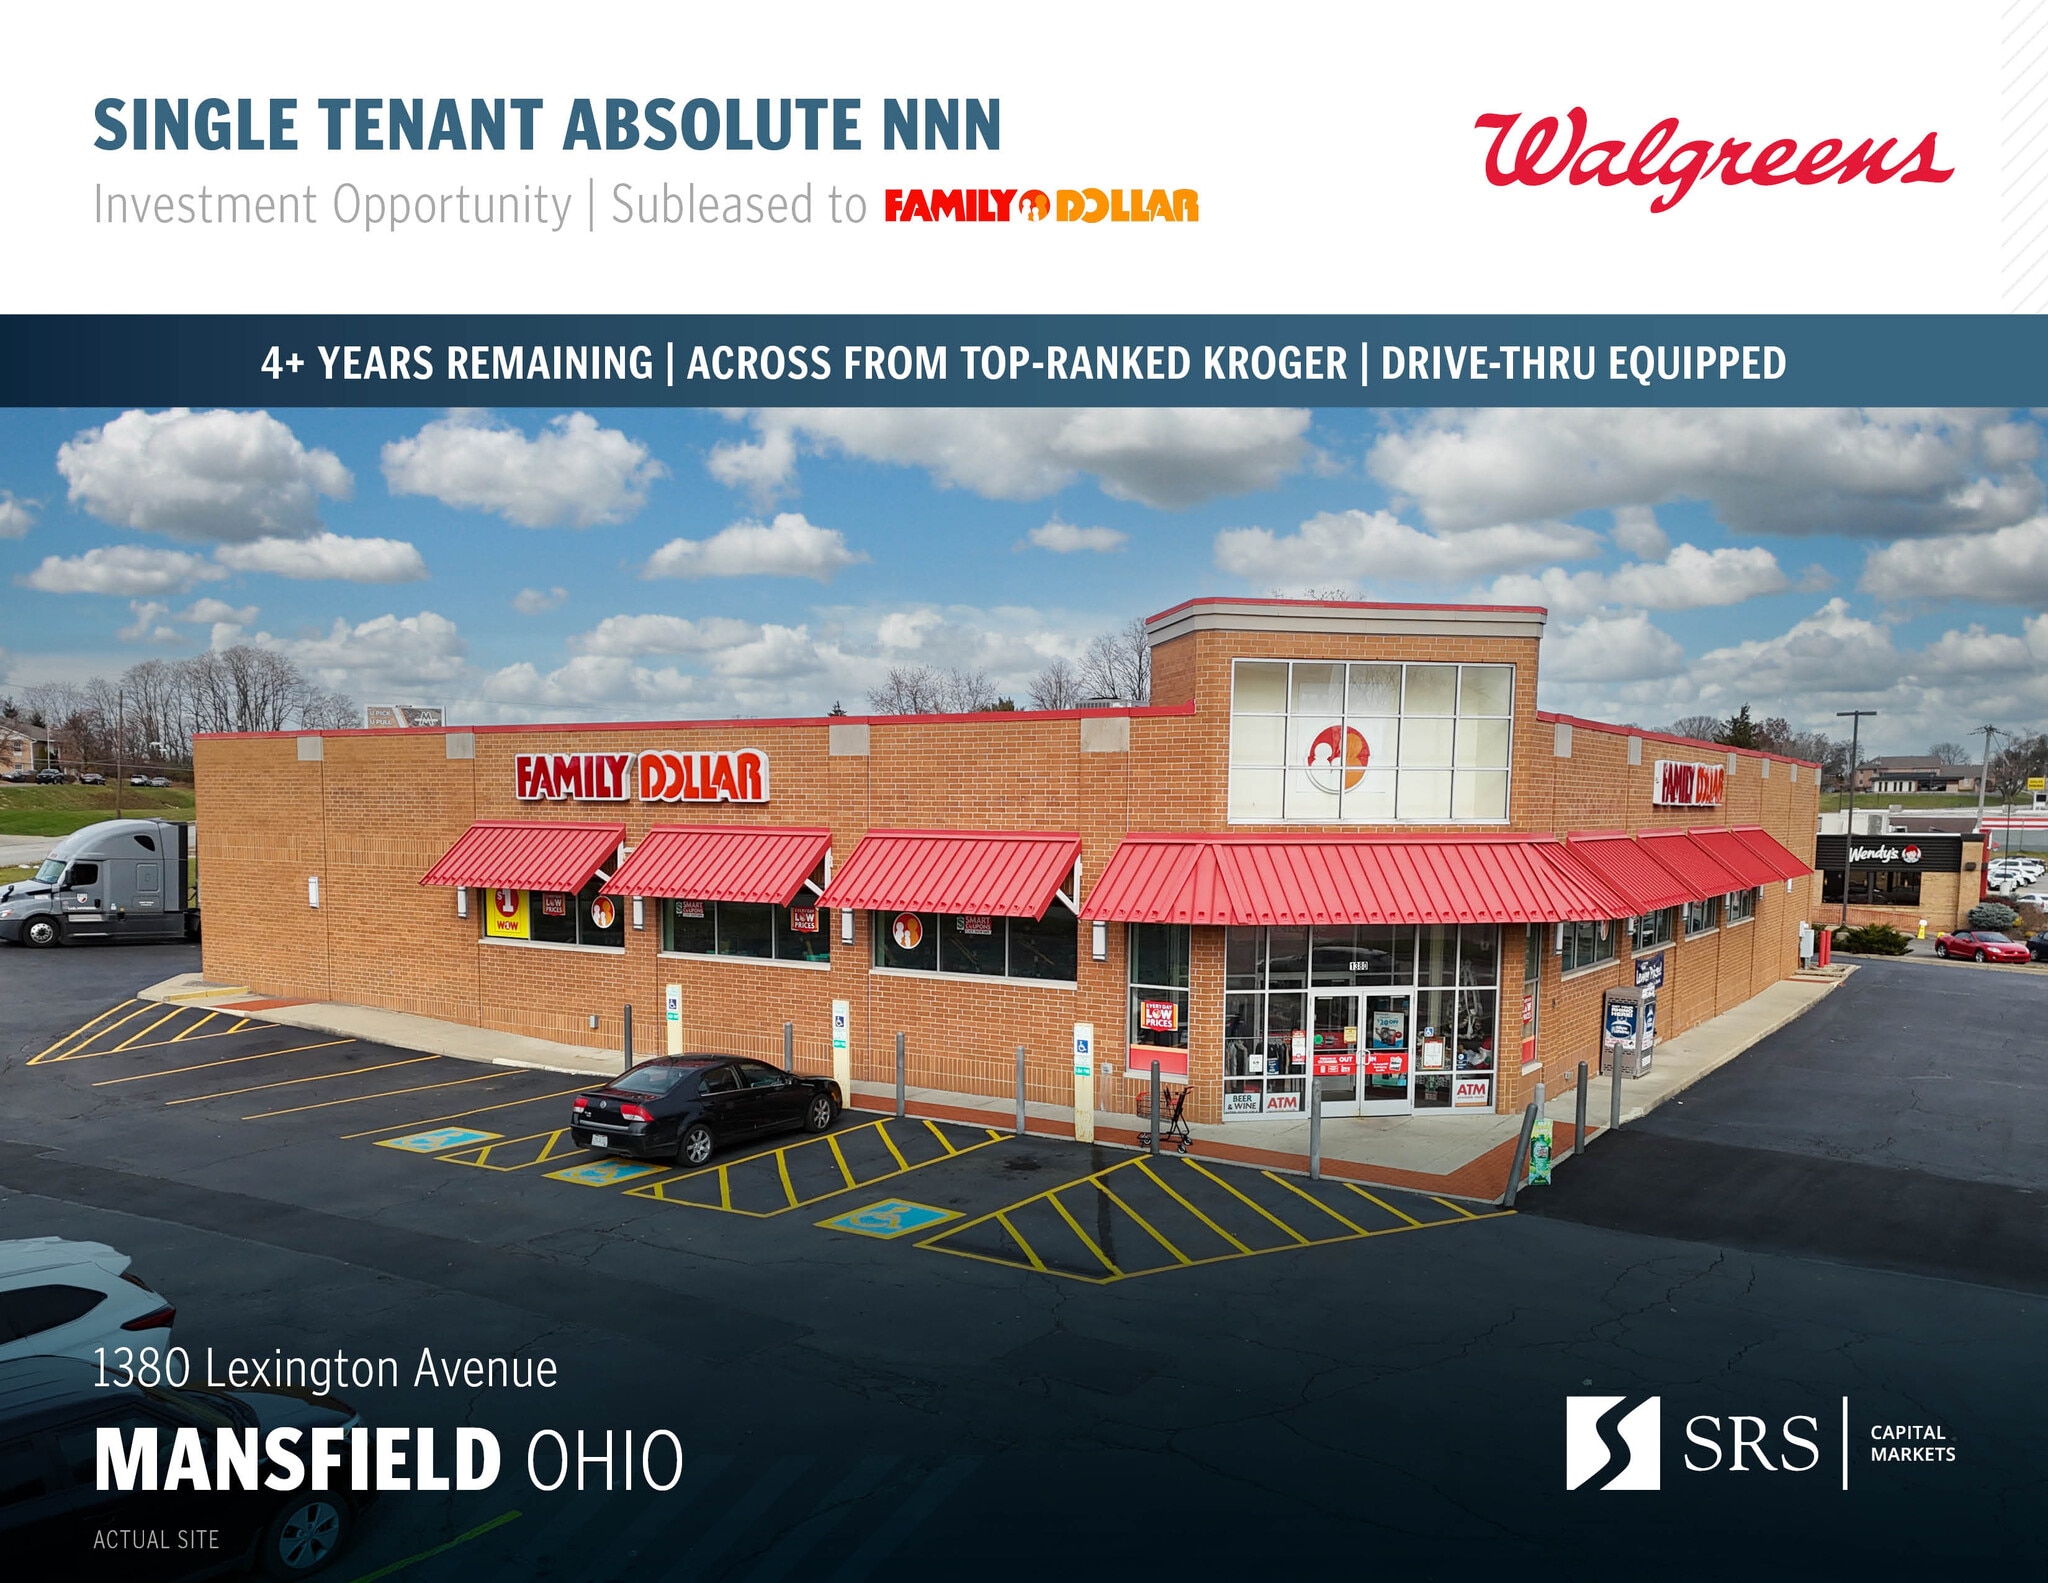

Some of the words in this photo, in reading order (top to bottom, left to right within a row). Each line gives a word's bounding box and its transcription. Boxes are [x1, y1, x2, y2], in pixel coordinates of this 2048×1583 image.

[516, 754, 629, 798] FAMILY
[639, 753, 762, 800] DOLLAR
[1662, 762, 1694, 804] FAMILY
[1849, 844, 1899, 863] Wendy's
[794, 921, 815, 929] PRICES
[965, 916, 991, 924] SMART
[1349, 961, 1368, 970] 1380
[1146, 1008, 1172, 1019] LOW
[1146, 1018, 1172, 1027] PRICES
[1457, 1083, 1486, 1095] ATM
[1267, 1096, 1297, 1109] ATM
